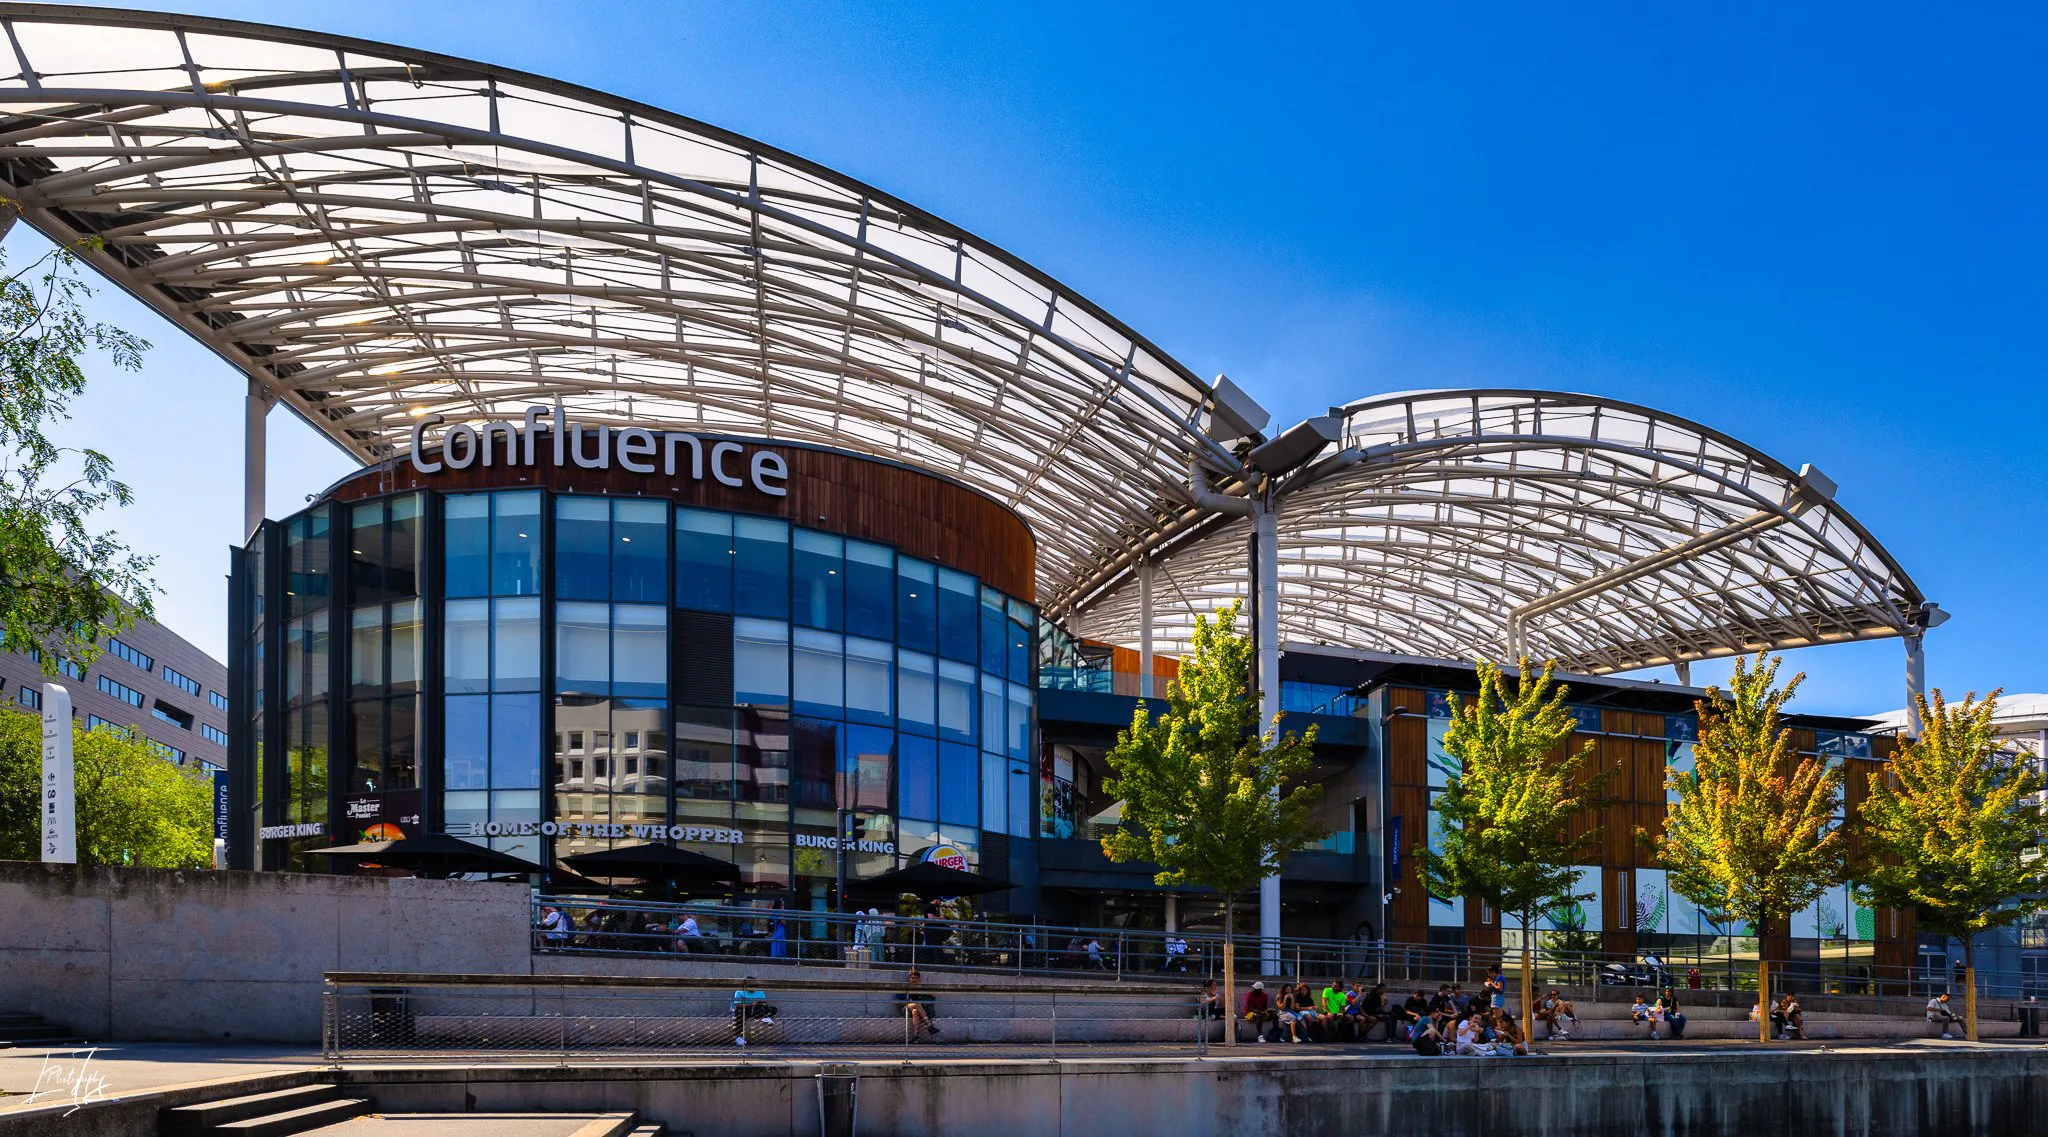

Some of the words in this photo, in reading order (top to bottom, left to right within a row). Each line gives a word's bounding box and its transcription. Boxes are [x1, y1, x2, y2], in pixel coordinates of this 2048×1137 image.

[411, 405, 788, 497] Confluence
[217, 785, 228, 840] onfluence
[346, 803, 380, 815] Master
[260, 825, 295, 840] BURGER
[296, 823, 320, 836] KING
[469, 820, 535, 836] HOME
[540, 821, 572, 836] OF
[577, 822, 625, 838] THE
[630, 823, 744, 844] WHOPPER
[859, 840, 895, 854] KING
[933, 856, 964, 867] URGER
